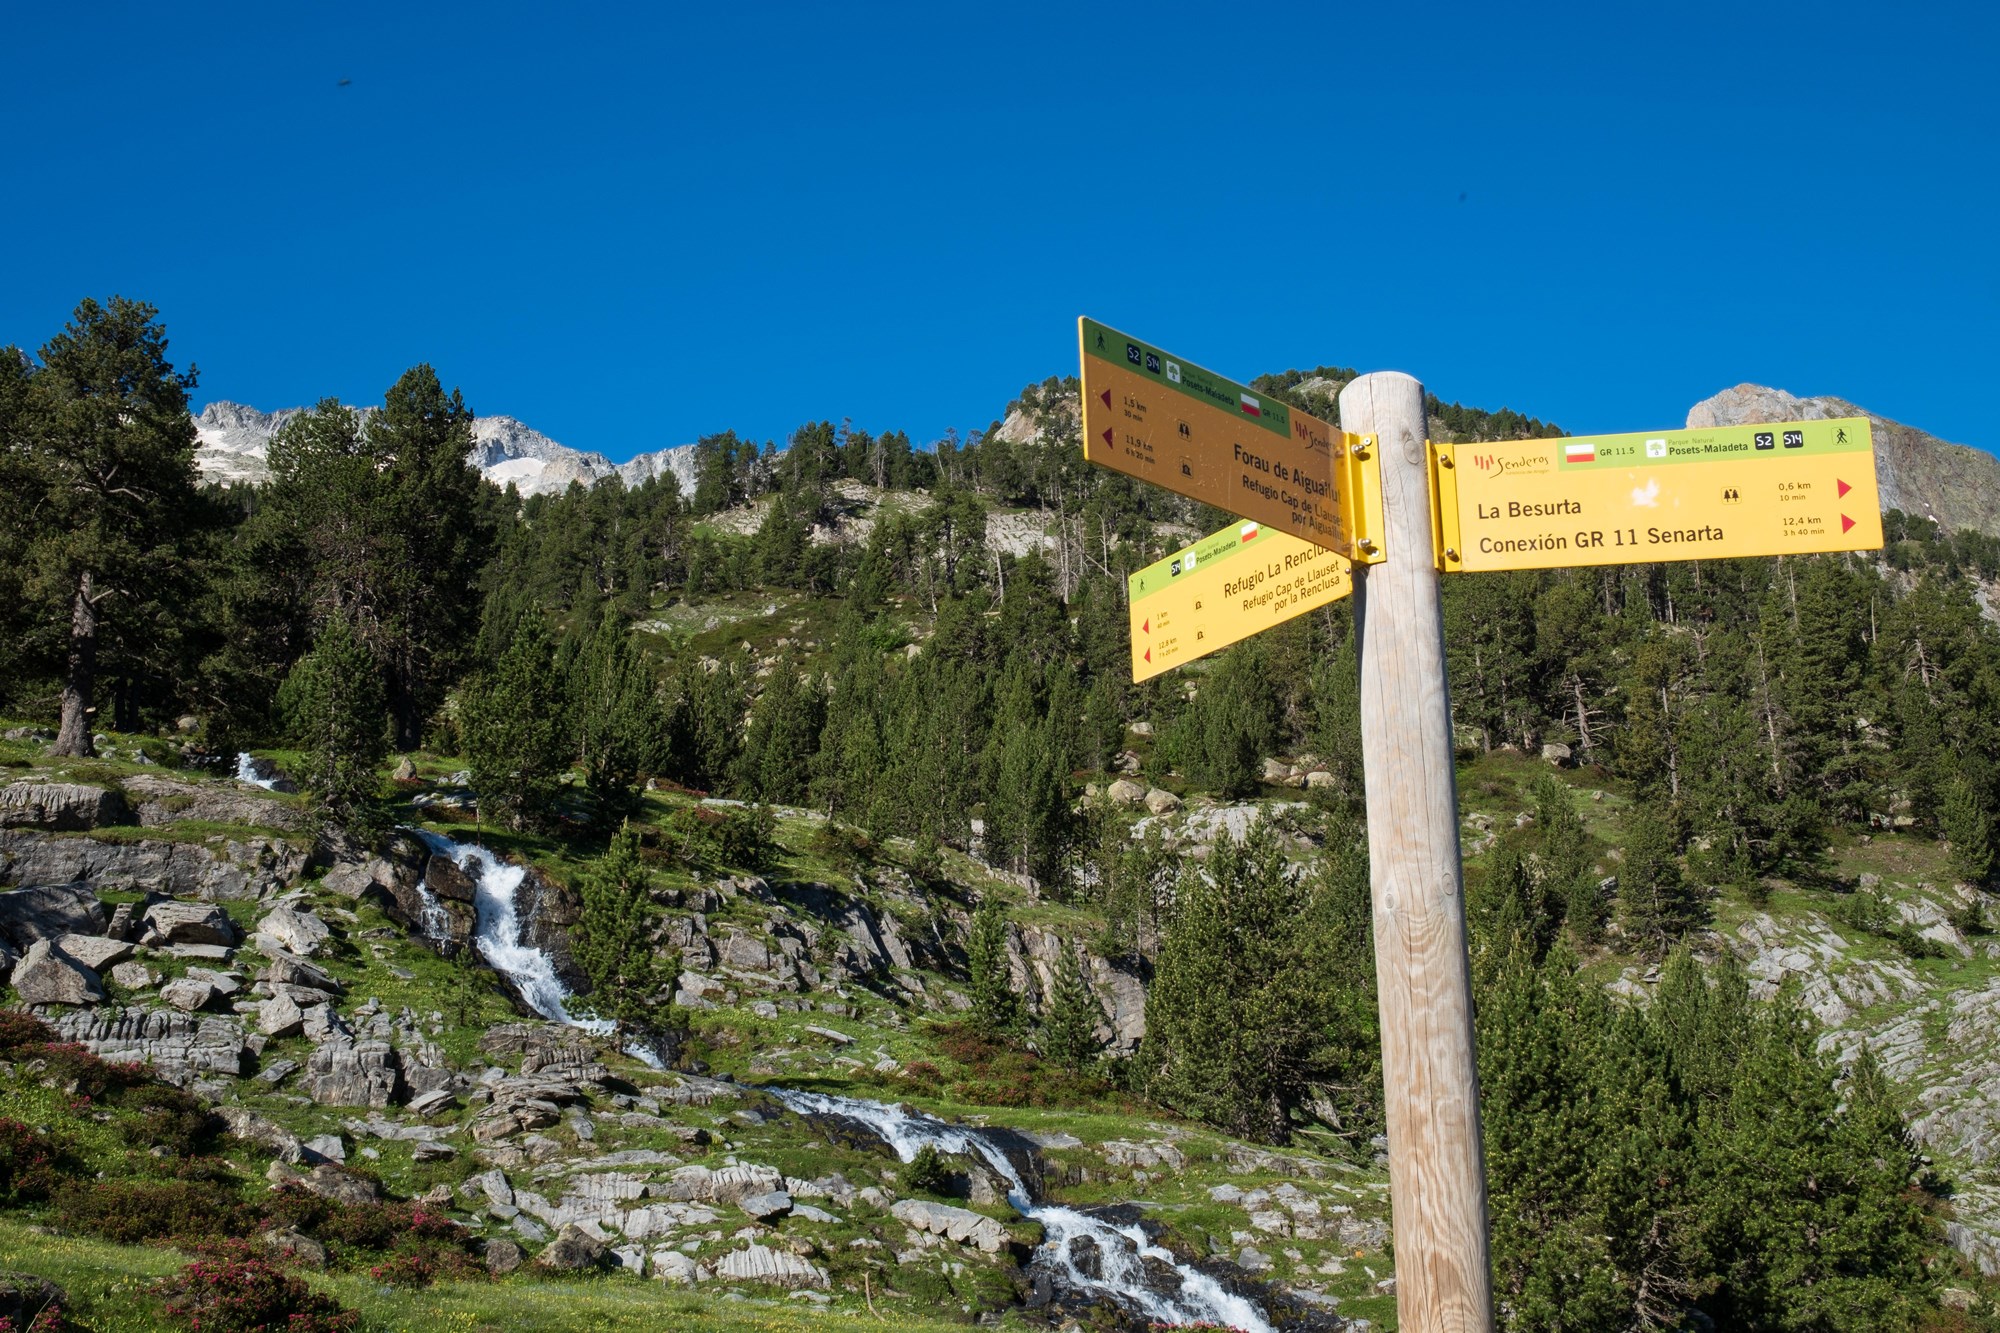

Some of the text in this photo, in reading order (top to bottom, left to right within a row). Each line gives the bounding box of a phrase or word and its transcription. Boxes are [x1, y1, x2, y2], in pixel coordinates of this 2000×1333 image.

[1127, 346, 1139, 361] S2
[1146, 355, 1160, 370] S14
[1182, 375, 1235, 406] Posets-Maladeta
[1136, 401, 1147, 413] km
[1143, 441, 1153, 452] km
[1756, 435, 1773, 447] S2
[1783, 433, 1803, 445] S14
[1599, 446, 1635, 457] GR 11.5
[1669, 442, 1749, 456] Posets-Maladeta
[1233, 443, 1270, 473] Forau
[1274, 462, 1289, 481] de
[1488, 455, 1549, 479] Senderos
[1242, 474, 1279, 500] Refugio
[1280, 490, 1299, 510] Cap
[1301, 499, 1312, 514] de
[1778, 481, 1812, 492] 0,6 km
[1779, 493, 1806, 502] 10 min
[1478, 499, 1582, 520] La Besurta
[1291, 511, 1306, 526] por
[1783, 516, 1822, 527] 12,4 km
[1479, 524, 1724, 554] Conexión GR 11 Senarta
[1783, 529, 1789, 537] 3
[1797, 528, 1809, 537] 40
[1810, 527, 1825, 535] min
[1196, 540, 1237, 565] Posets-Maladeta
[1224, 569, 1265, 599] Refugio
[1267, 563, 1281, 579] La
[1242, 559, 1340, 612] Refugio Cap de Llauset
[1274, 575, 1340, 614] por la Renclusa
